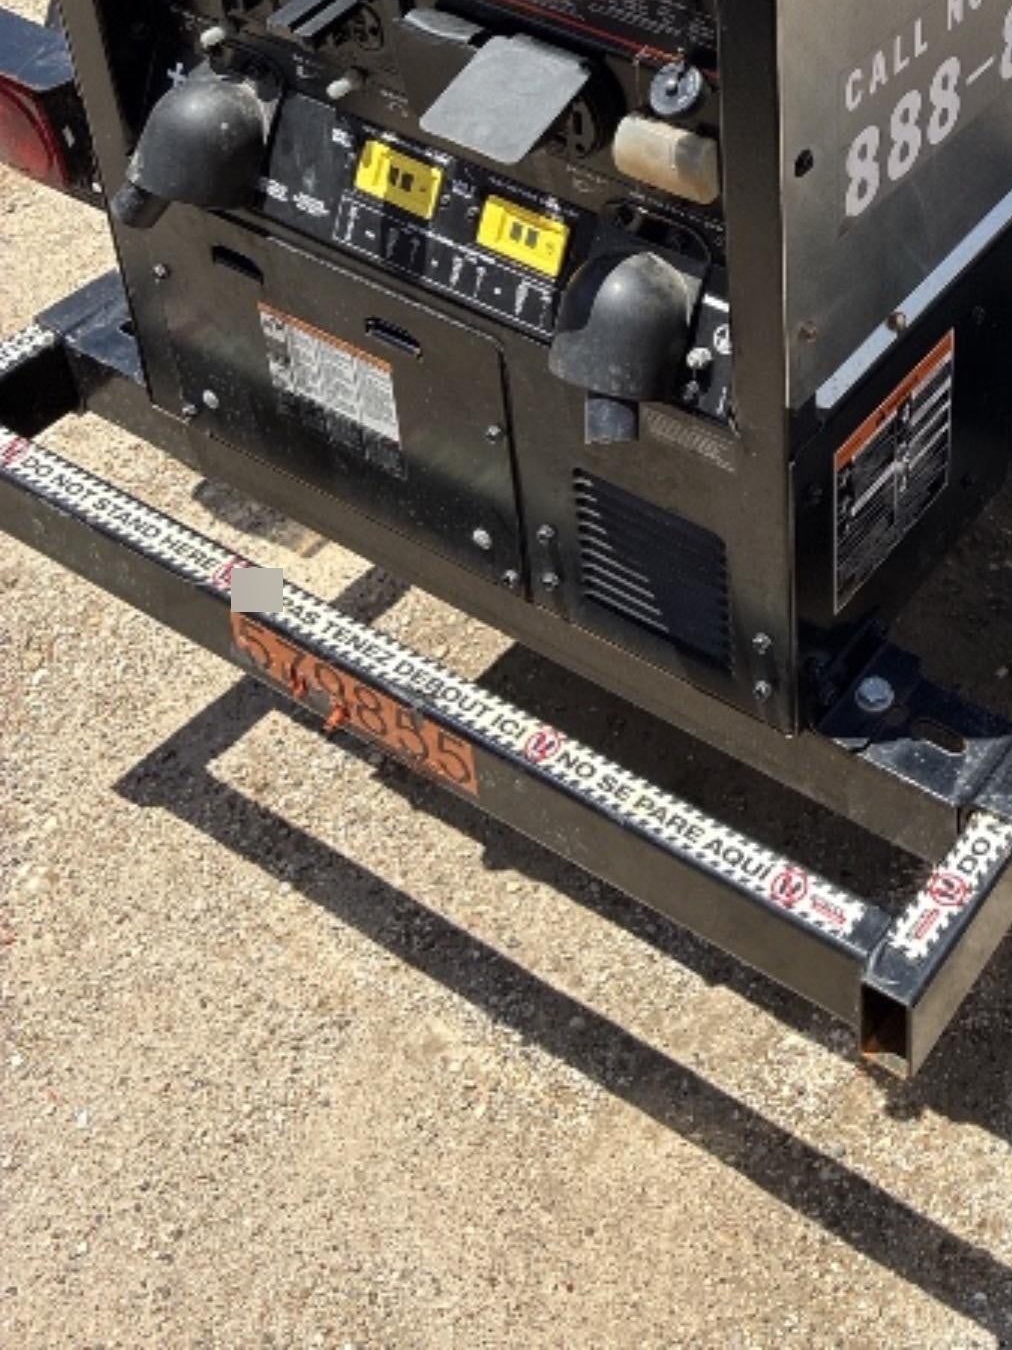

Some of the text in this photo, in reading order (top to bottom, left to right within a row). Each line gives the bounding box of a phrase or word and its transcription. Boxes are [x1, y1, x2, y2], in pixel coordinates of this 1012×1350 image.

[845, 18, 927, 112] CALL
[21, 456, 224, 571] DO NOT STAND HERE
[321, 620, 398, 668] TENEZ
[393, 659, 496, 717] DEBOUT
[491, 711, 528, 740] ICI
[556, 752, 595, 779] NO
[597, 774, 636, 802] SE
[634, 795, 705, 843] PARE
[957, 836, 991, 874] DO
